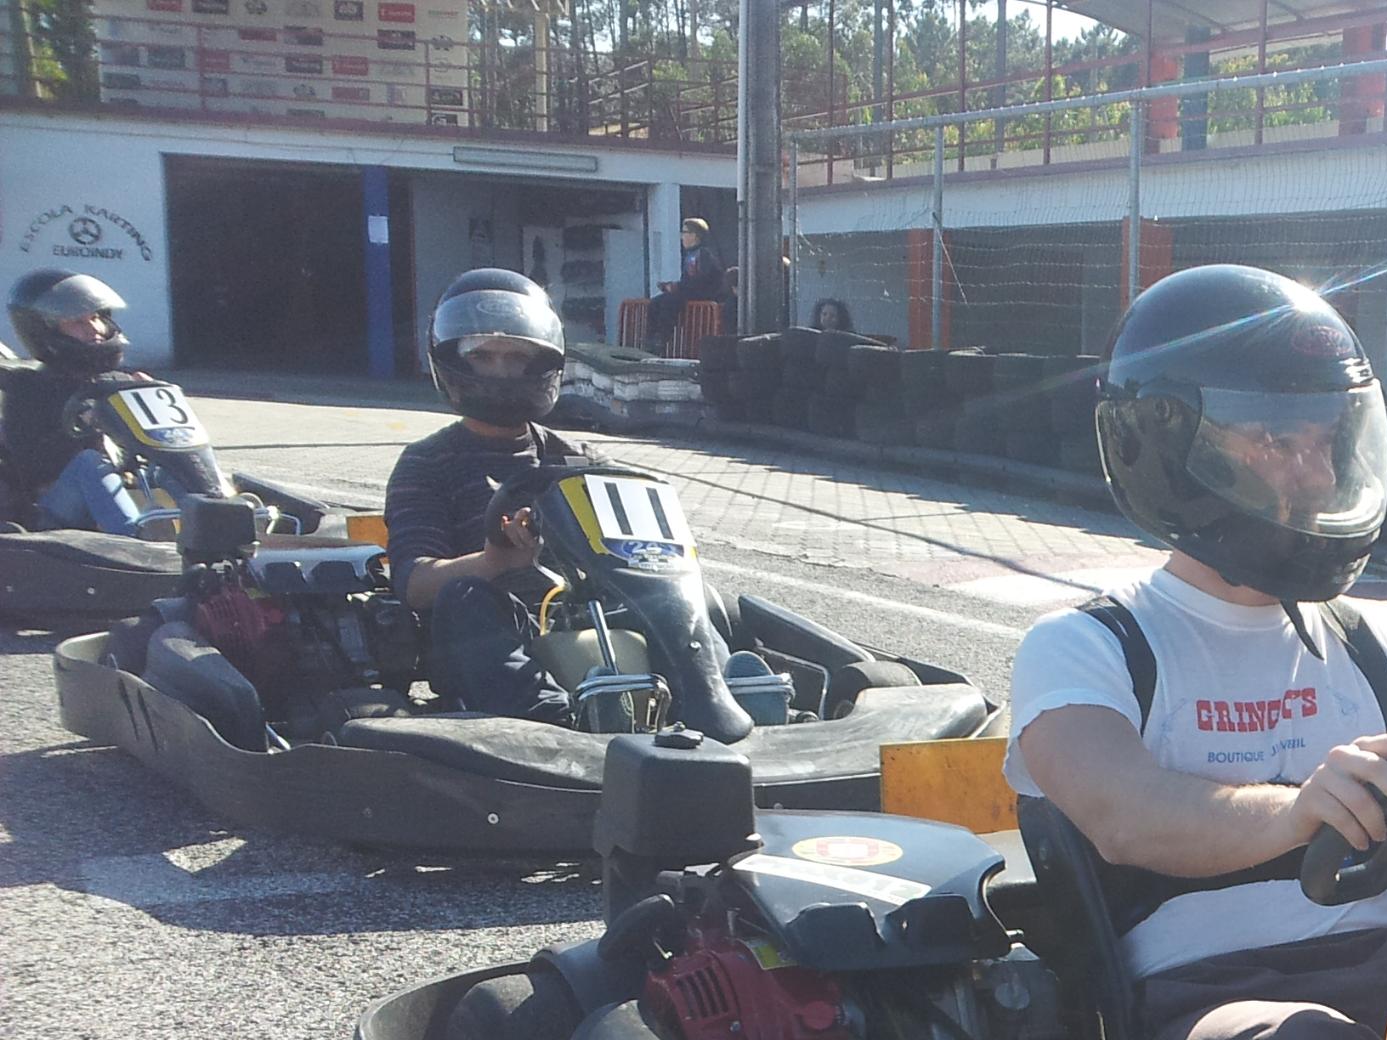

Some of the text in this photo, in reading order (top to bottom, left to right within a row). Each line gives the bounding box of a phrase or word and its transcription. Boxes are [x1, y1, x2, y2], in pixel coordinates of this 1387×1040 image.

[19, 203, 153, 262] ESCOLA KARTING
[52, 244, 123, 260] EUROINDY
[130, 388, 189, 426] 13
[603, 481, 675, 540] 11
[1207, 750, 1265, 763] BOUTIQUE
